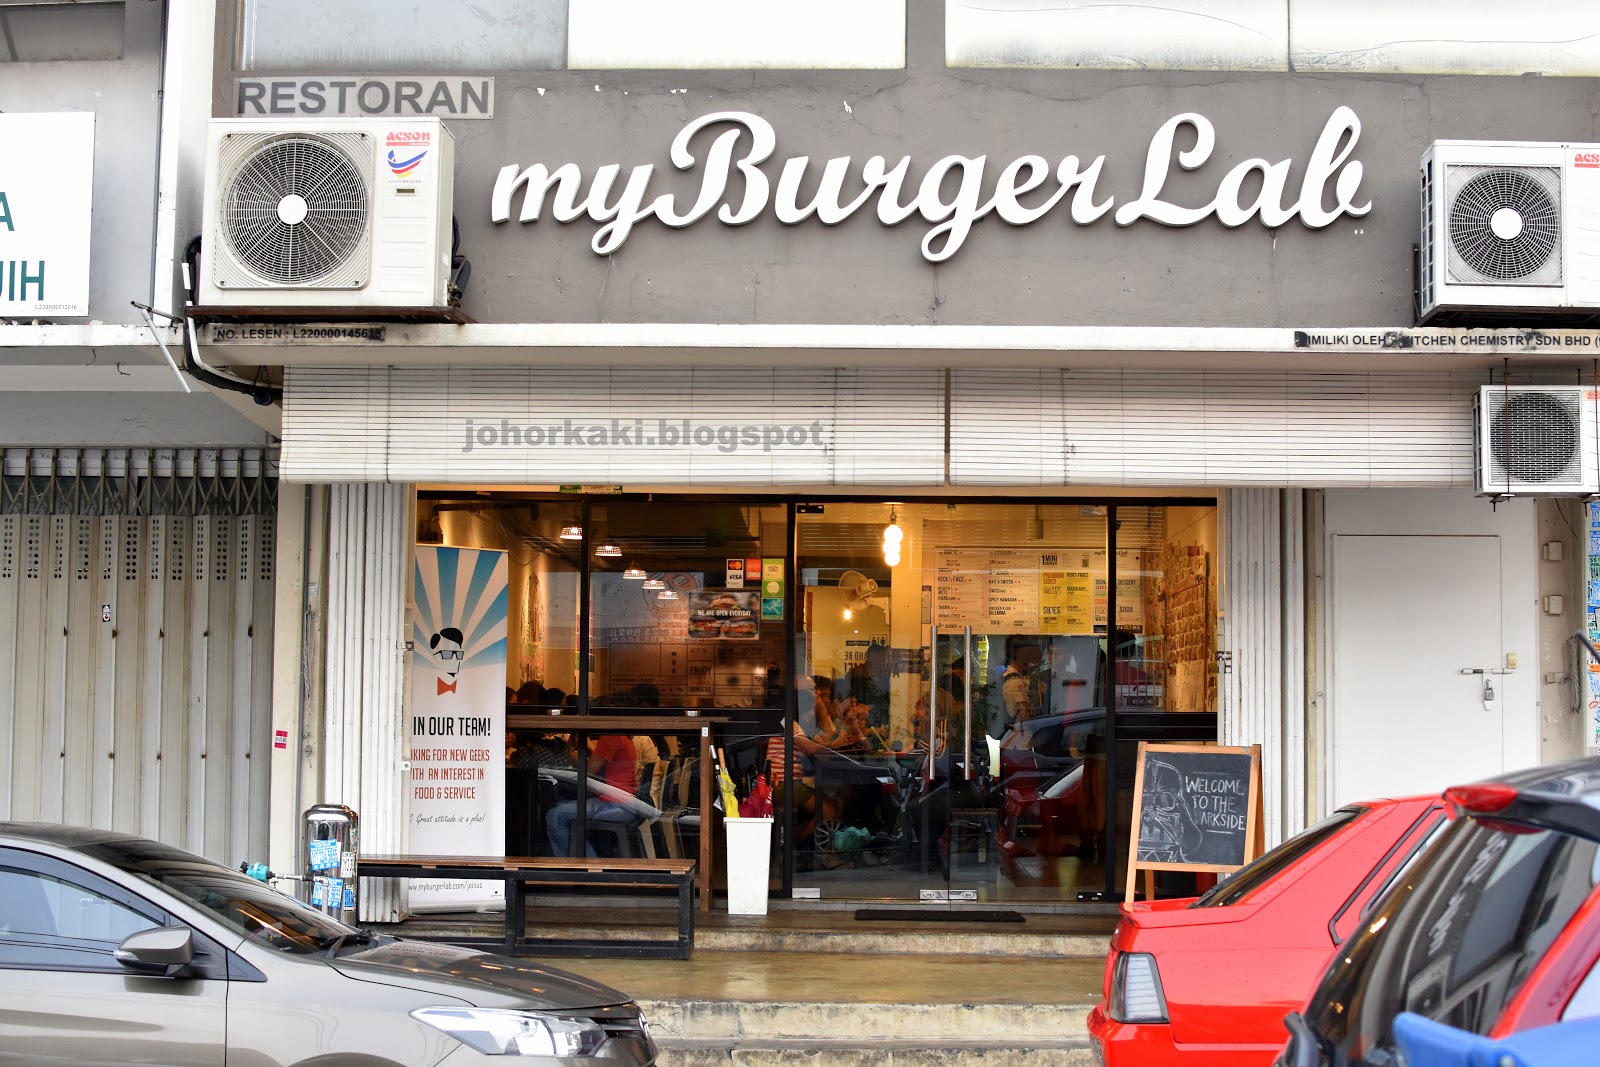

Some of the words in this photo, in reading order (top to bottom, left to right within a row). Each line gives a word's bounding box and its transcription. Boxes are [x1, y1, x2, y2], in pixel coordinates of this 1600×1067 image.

[237, 81, 489, 115] RESTORAN
[386, 131, 431, 141] ACSON
[0, 260, 45, 301] IH
[217, 329, 238, 340] NO.
[242, 329, 282, 339] LESEN
[1296, 334, 1349, 346] IMILIKI
[1352, 335, 1386, 346] OLEH
[1460, 335, 1531, 346] CHEMISTRY
[1535, 335, 1561, 346] SDN
[1565, 335, 1591, 346] BHD
[690, 666, 712, 676] ENJOY
[413, 716, 425, 736] IN
[429, 716, 454, 736] OUR
[458, 717, 491, 737] TEAM!
[410, 748, 431, 761] KING
[432, 749, 448, 761] FOR
[450, 749, 468, 761] NEW
[469, 749, 490, 762] GEEKS
[411, 767, 424, 780] ITH
[428, 768, 438, 780] AN
[441, 768, 476, 780] INTEREST
[477, 768, 484, 780] IN
[1185, 776, 1245, 796] WELCOME
[414, 787, 435, 800] FOOD
[436, 787, 442, 799] &
[443, 787, 476, 799] SERVICE
[1192, 795, 1208, 810] TO
[1211, 795, 1237, 813] THE
[416, 813, 434, 825] Great
[434, 813, 457, 823] attitude
[469, 812, 487, 826] plus!
